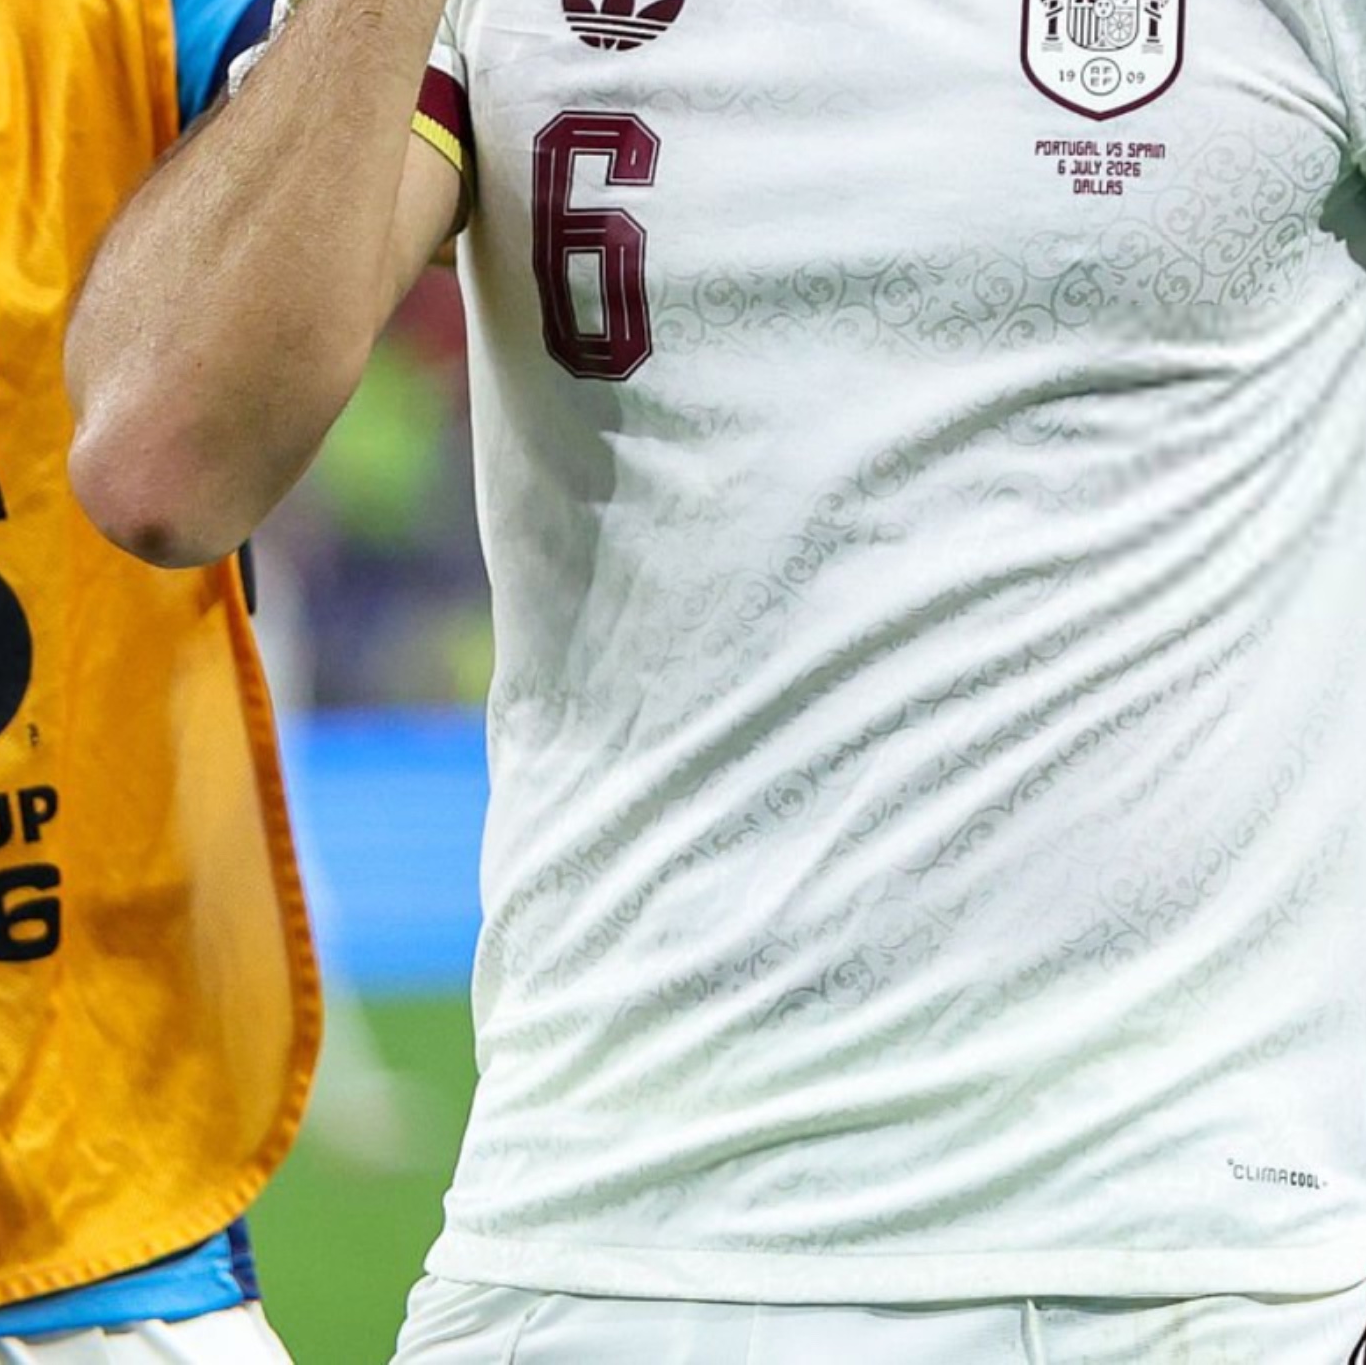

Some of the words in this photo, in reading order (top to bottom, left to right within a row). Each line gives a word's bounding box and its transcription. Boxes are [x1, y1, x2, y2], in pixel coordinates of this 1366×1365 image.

[1059, 69, 1076, 82] 19
[1126, 71, 1145, 84] 09
[1034, 140, 1101, 156] PORTUGAL
[1106, 141, 1123, 157] VS
[1127, 142, 1166, 159] SPAIN
[1057, 159, 1066, 175] 6
[1070, 160, 1102, 175] JULY
[1106, 161, 1142, 177] 2026
[1073, 178, 1123, 195] DALLAS
[533, 110, 660, 381] 6
